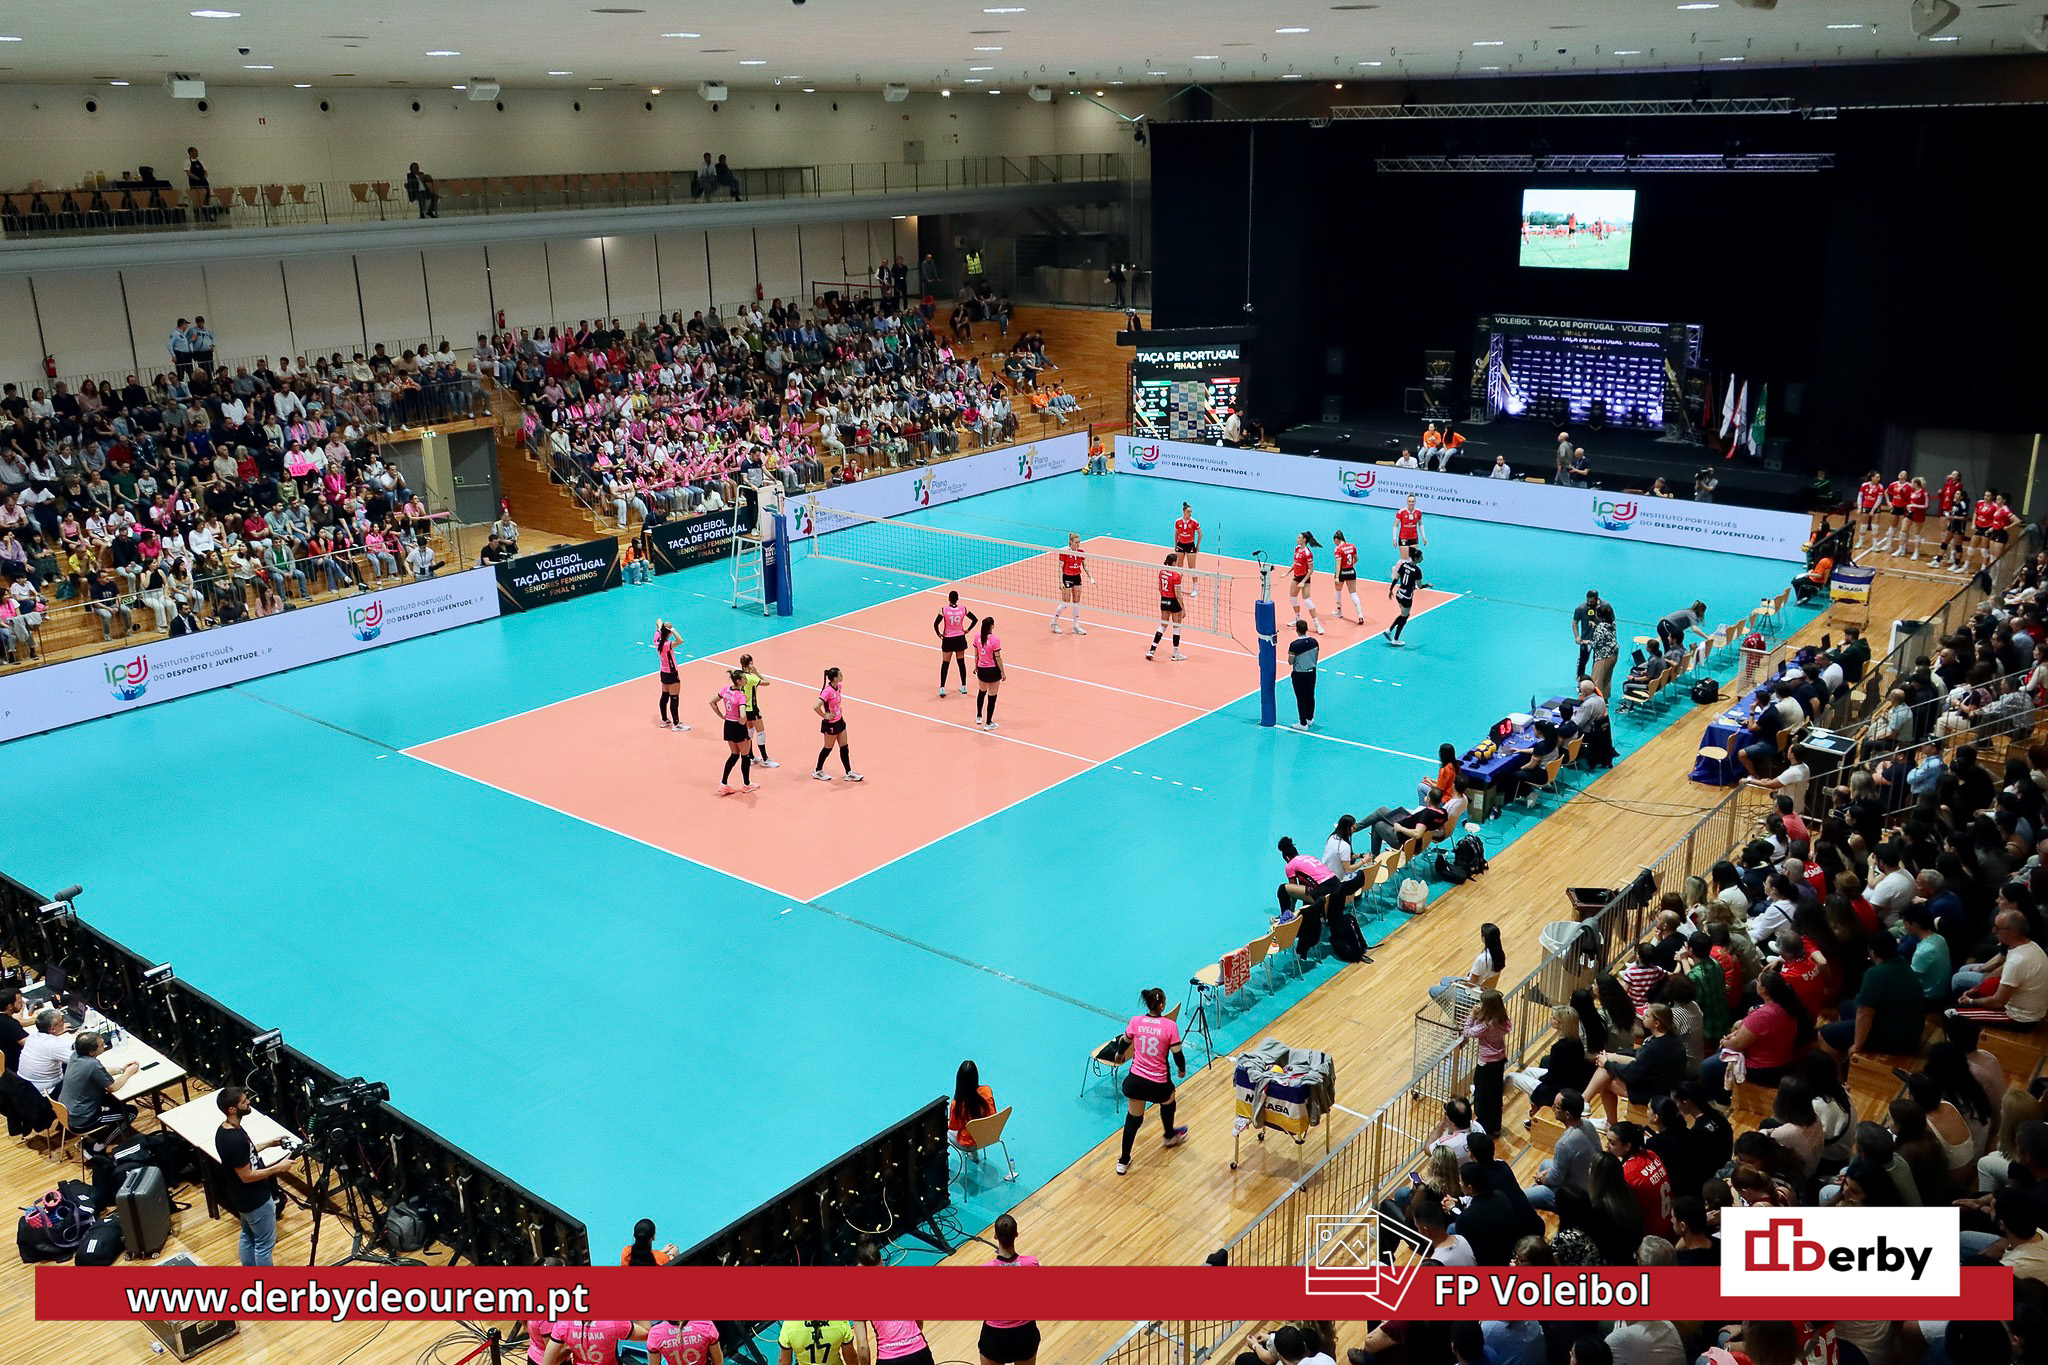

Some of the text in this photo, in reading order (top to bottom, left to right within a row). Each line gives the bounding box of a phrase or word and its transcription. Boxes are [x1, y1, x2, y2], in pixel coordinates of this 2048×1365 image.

[1495, 317, 1662, 334] VOLEIBOL TAÇA DE PORTUGAL VOLEIBOL
[1136, 350, 1240, 364] TAÇA DE PORTUGAL
[1174, 362, 1196, 370] FINAL
[1162, 454, 1228, 466] INSTITUTO PORTUGUÊS
[1172, 462, 1204, 470] DESPORTO
[932, 480, 948, 488] Plano
[1378, 480, 1458, 494] INSTITUTO PORTUGUÊS
[1592, 496, 1638, 520] ipdj
[686, 518, 726, 534] VOLEIBOL
[1640, 512, 1738, 528] INSTITUTO PORTUGUÊS
[1654, 522, 1702, 532] DESPORTO
[668, 538, 690, 550] TAÇA
[692, 534, 702, 544] DE
[698, 550, 716, 558] FINAL
[1346, 554, 1352, 565] 3
[536, 553, 582, 570] VOLEIBOL
[513, 558, 606, 587] TAÇA DE PORTUGAL
[560, 570, 598, 584] FEMININOS
[1402, 573, 1410, 586] 11
[550, 586, 570, 596] FINAL
[1162, 578, 1168, 592] 12
[1838, 584, 1863, 592] MIKASA
[384, 594, 452, 614] INSTITUTO PORTUGUÊS
[348, 600, 384, 628] ipdj
[386, 616, 396, 624] DO
[397, 609, 432, 622] DESPORTO
[950, 616, 961, 626] 19
[151, 646, 234, 670] INSTITUTO PORTUGUÊS
[104, 654, 148, 687] ipdj
[153, 674, 165, 682] DO
[166, 663, 208, 678] DESPORTO
[726, 700, 732, 712] 6
[1304, 856, 1322, 868] 15
[1138, 1026, 1162, 1036] EVELYN
[1139, 1036, 1160, 1056] 18
[572, 1331, 604, 1340] MARIANA
[660, 1332, 704, 1349] CEREIRA
[573, 1343, 604, 1363] 16
[804, 1342, 832, 1364] 17
